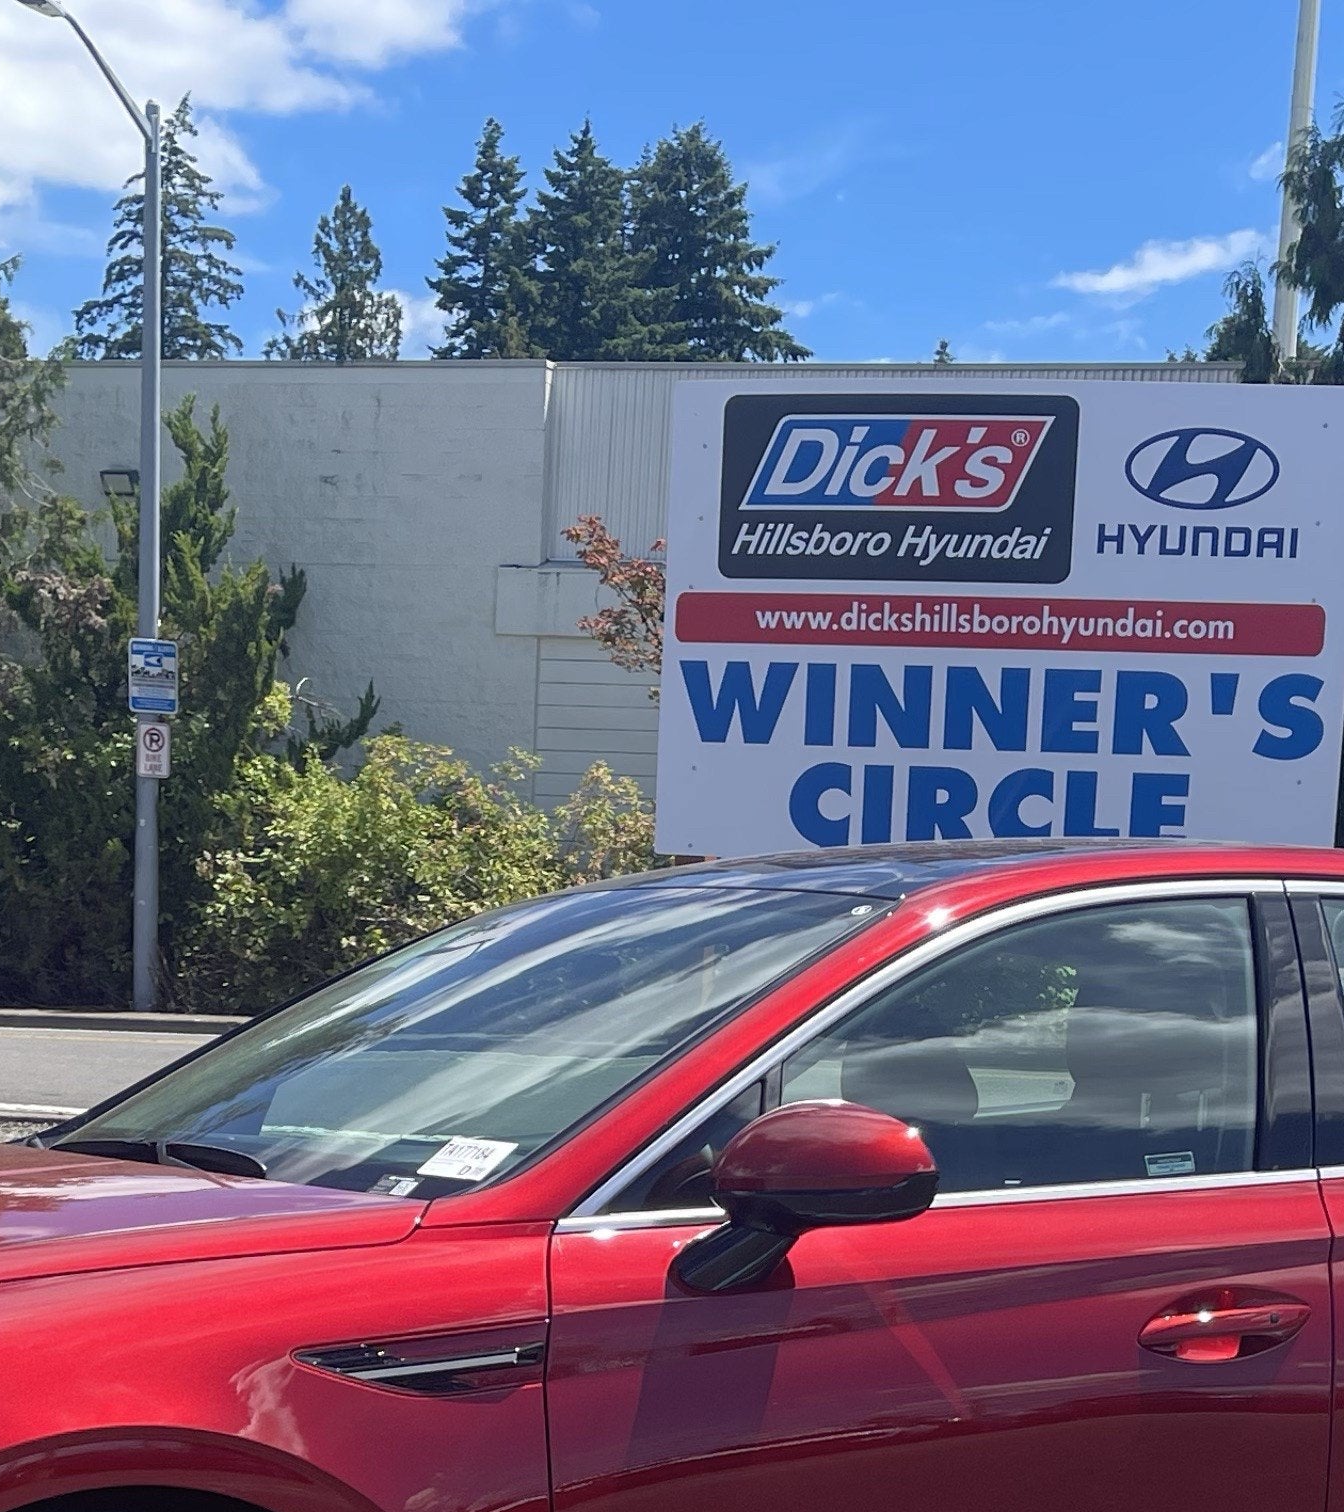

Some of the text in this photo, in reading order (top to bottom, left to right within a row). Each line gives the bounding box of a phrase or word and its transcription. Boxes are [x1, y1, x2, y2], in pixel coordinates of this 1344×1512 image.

[732, 523, 1052, 566] Hillsboro Hyundai
[1097, 523, 1298, 559] HYUNDAI
[756, 602, 1234, 643] www.dickshillsborohyundai.com
[680, 660, 1325, 760] WINNER'S
